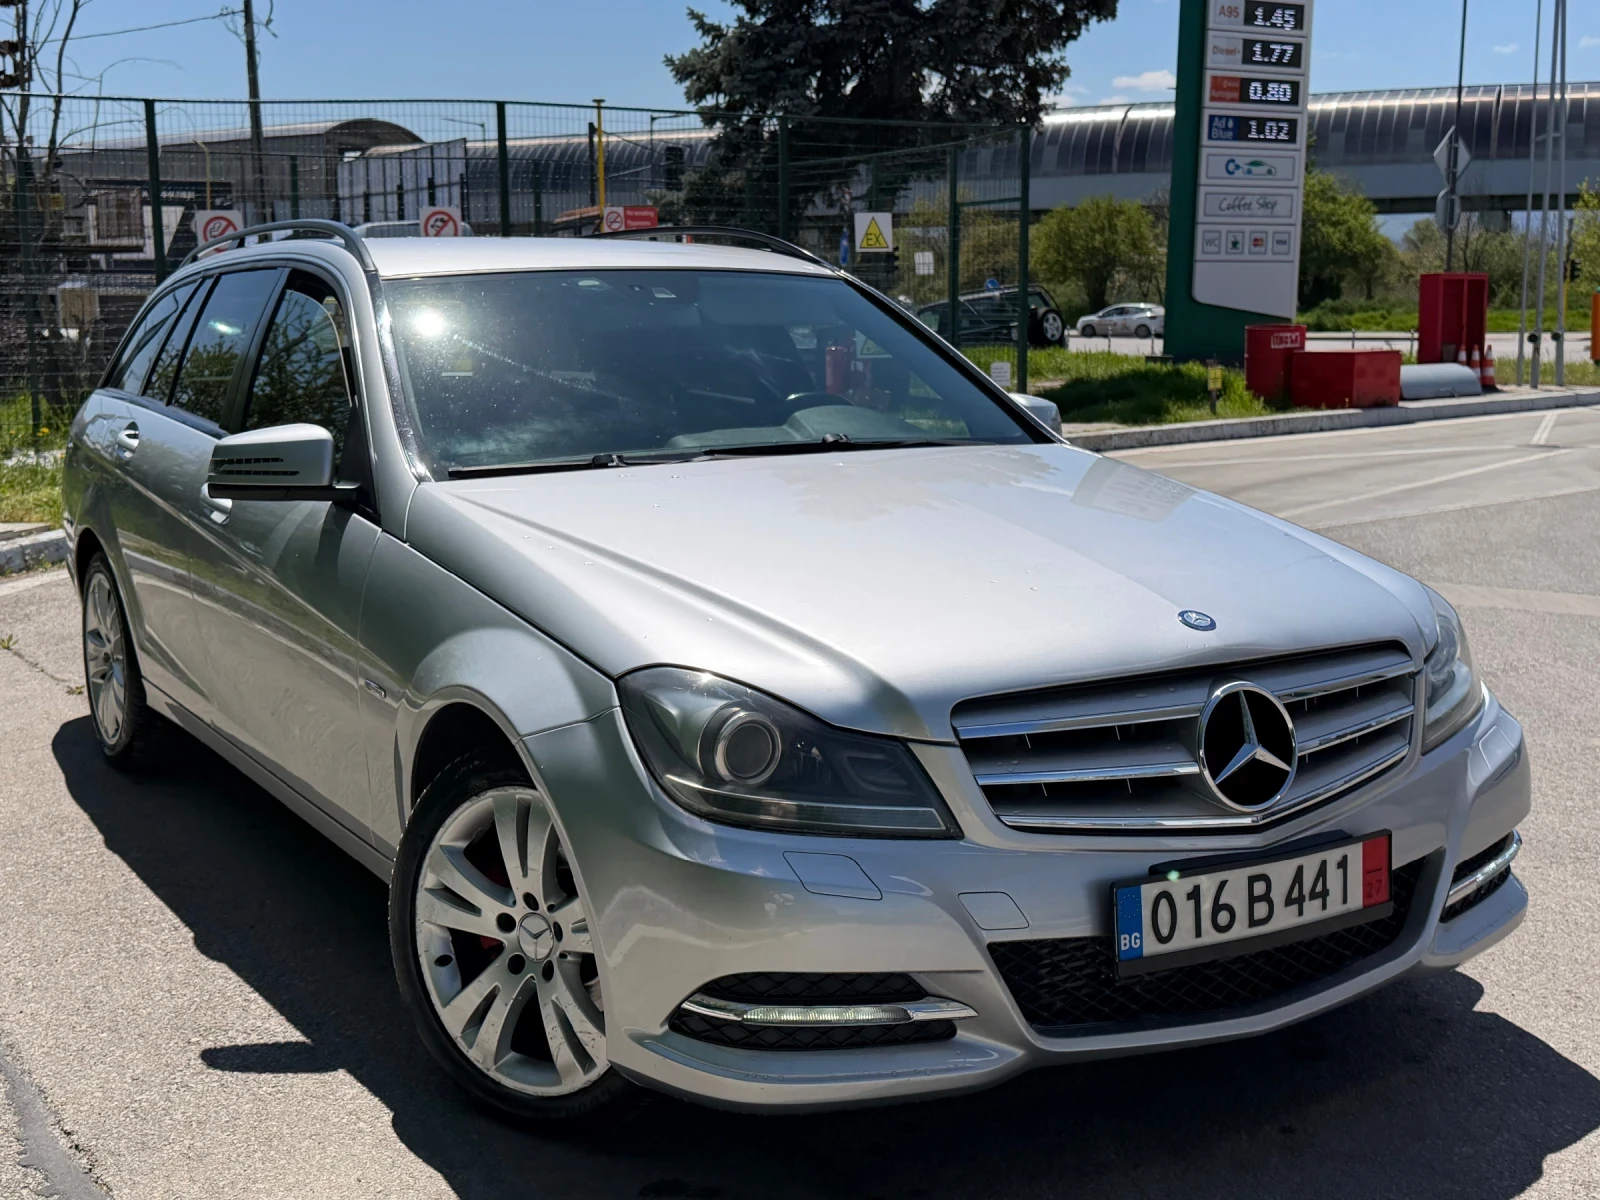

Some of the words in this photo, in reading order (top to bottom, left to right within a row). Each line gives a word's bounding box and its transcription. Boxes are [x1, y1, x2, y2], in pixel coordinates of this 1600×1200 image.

[1219, 5, 1240, 19] A95
[1253, 7, 1296, 31] 1.45
[1252, 42, 1294, 63] 1.77
[1211, 127, 1233, 139] Blue
[1248, 120, 1289, 140] 1.02
[1218, 197, 1252, 212] Coffee
[1256, 197, 1277, 215] Shop
[866, 233, 882, 246] EX
[1120, 932, 1141, 951] BG
